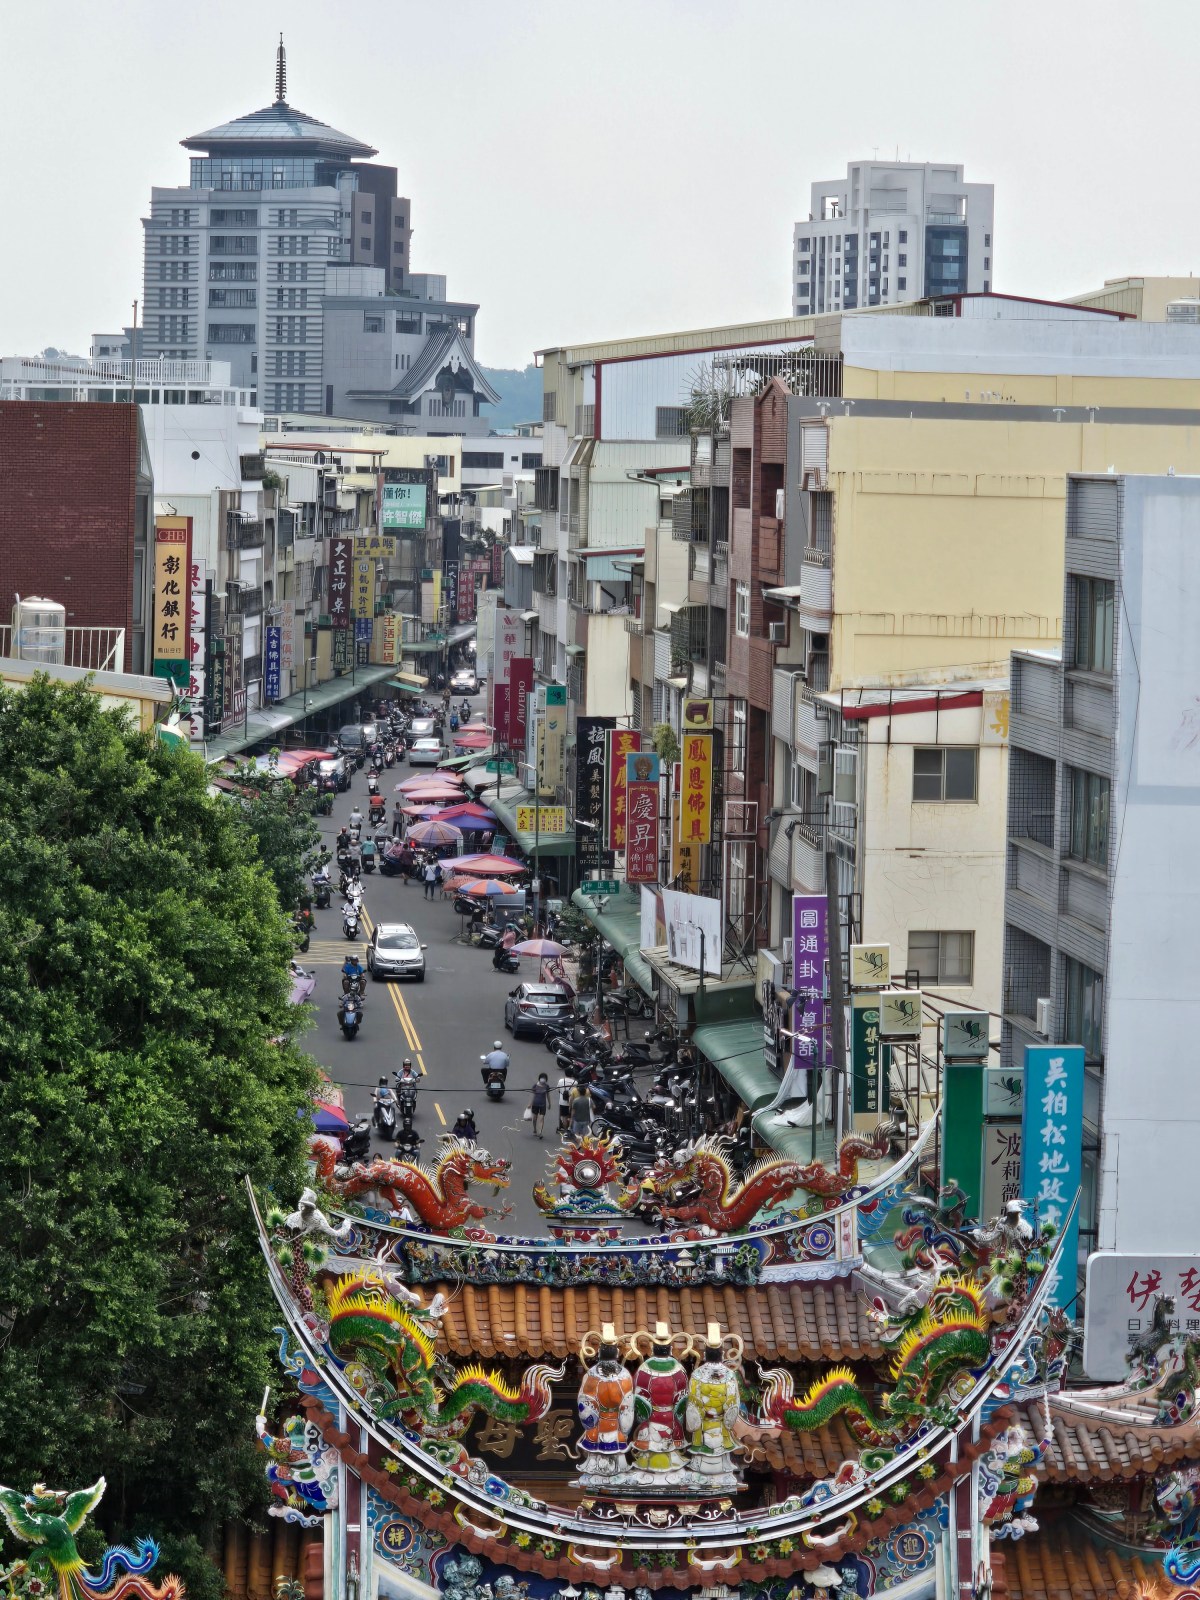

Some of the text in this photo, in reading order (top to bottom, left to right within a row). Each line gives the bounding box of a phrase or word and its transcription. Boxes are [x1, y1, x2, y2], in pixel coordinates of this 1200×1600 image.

[158, 530, 184, 541] CHB
[357, 537, 394, 549] 耳鼻喉
[161, 555, 181, 641] 彰化銀行
[331, 541, 348, 614] 大正神桌
[268, 627, 279, 683] 大吉佛具行
[384, 616, 396, 662] 生活百貨
[687, 739, 707, 841] 鳳恩佛具
[630, 794, 656, 849] 慶昇
[1128, 1319, 1200, 1331] 日料理
